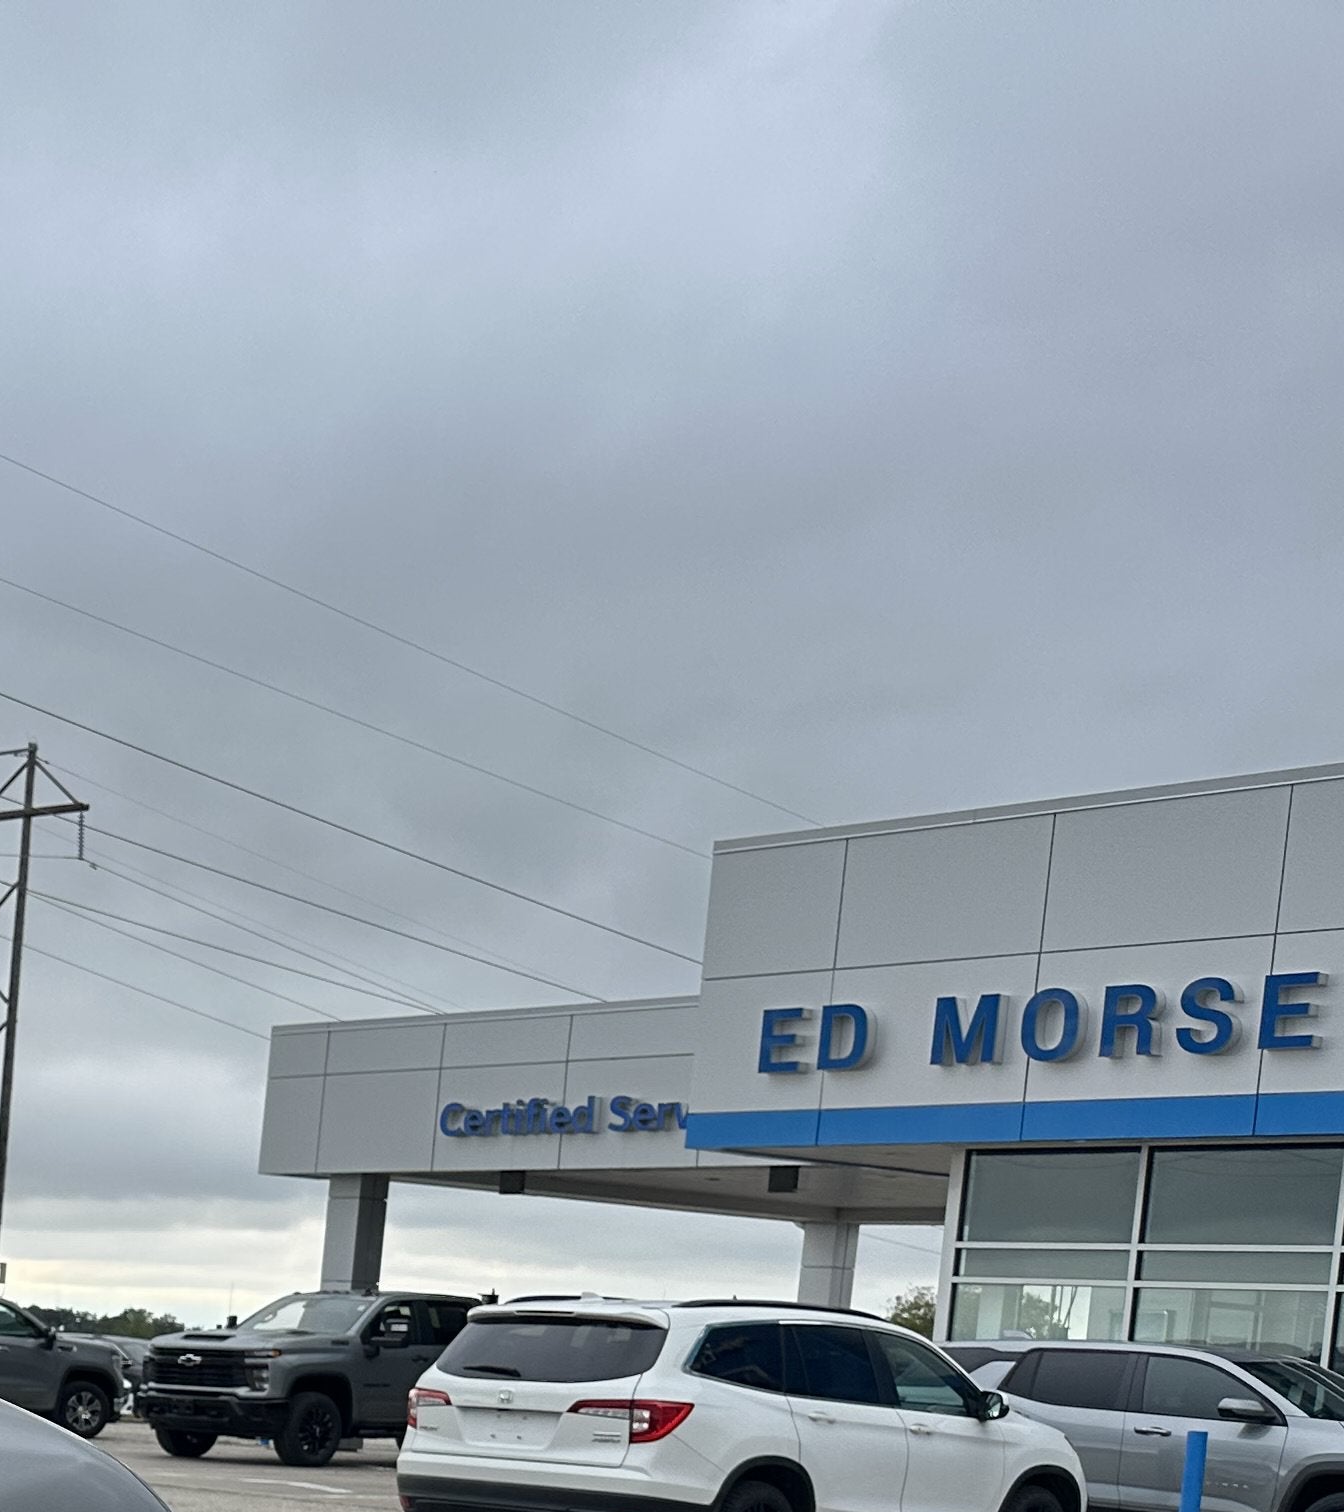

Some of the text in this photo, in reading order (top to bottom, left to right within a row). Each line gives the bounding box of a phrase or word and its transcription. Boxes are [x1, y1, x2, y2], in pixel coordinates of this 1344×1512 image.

[757, 971, 1326, 1074] ED MORSE
[439, 1094, 601, 1138] Certified
